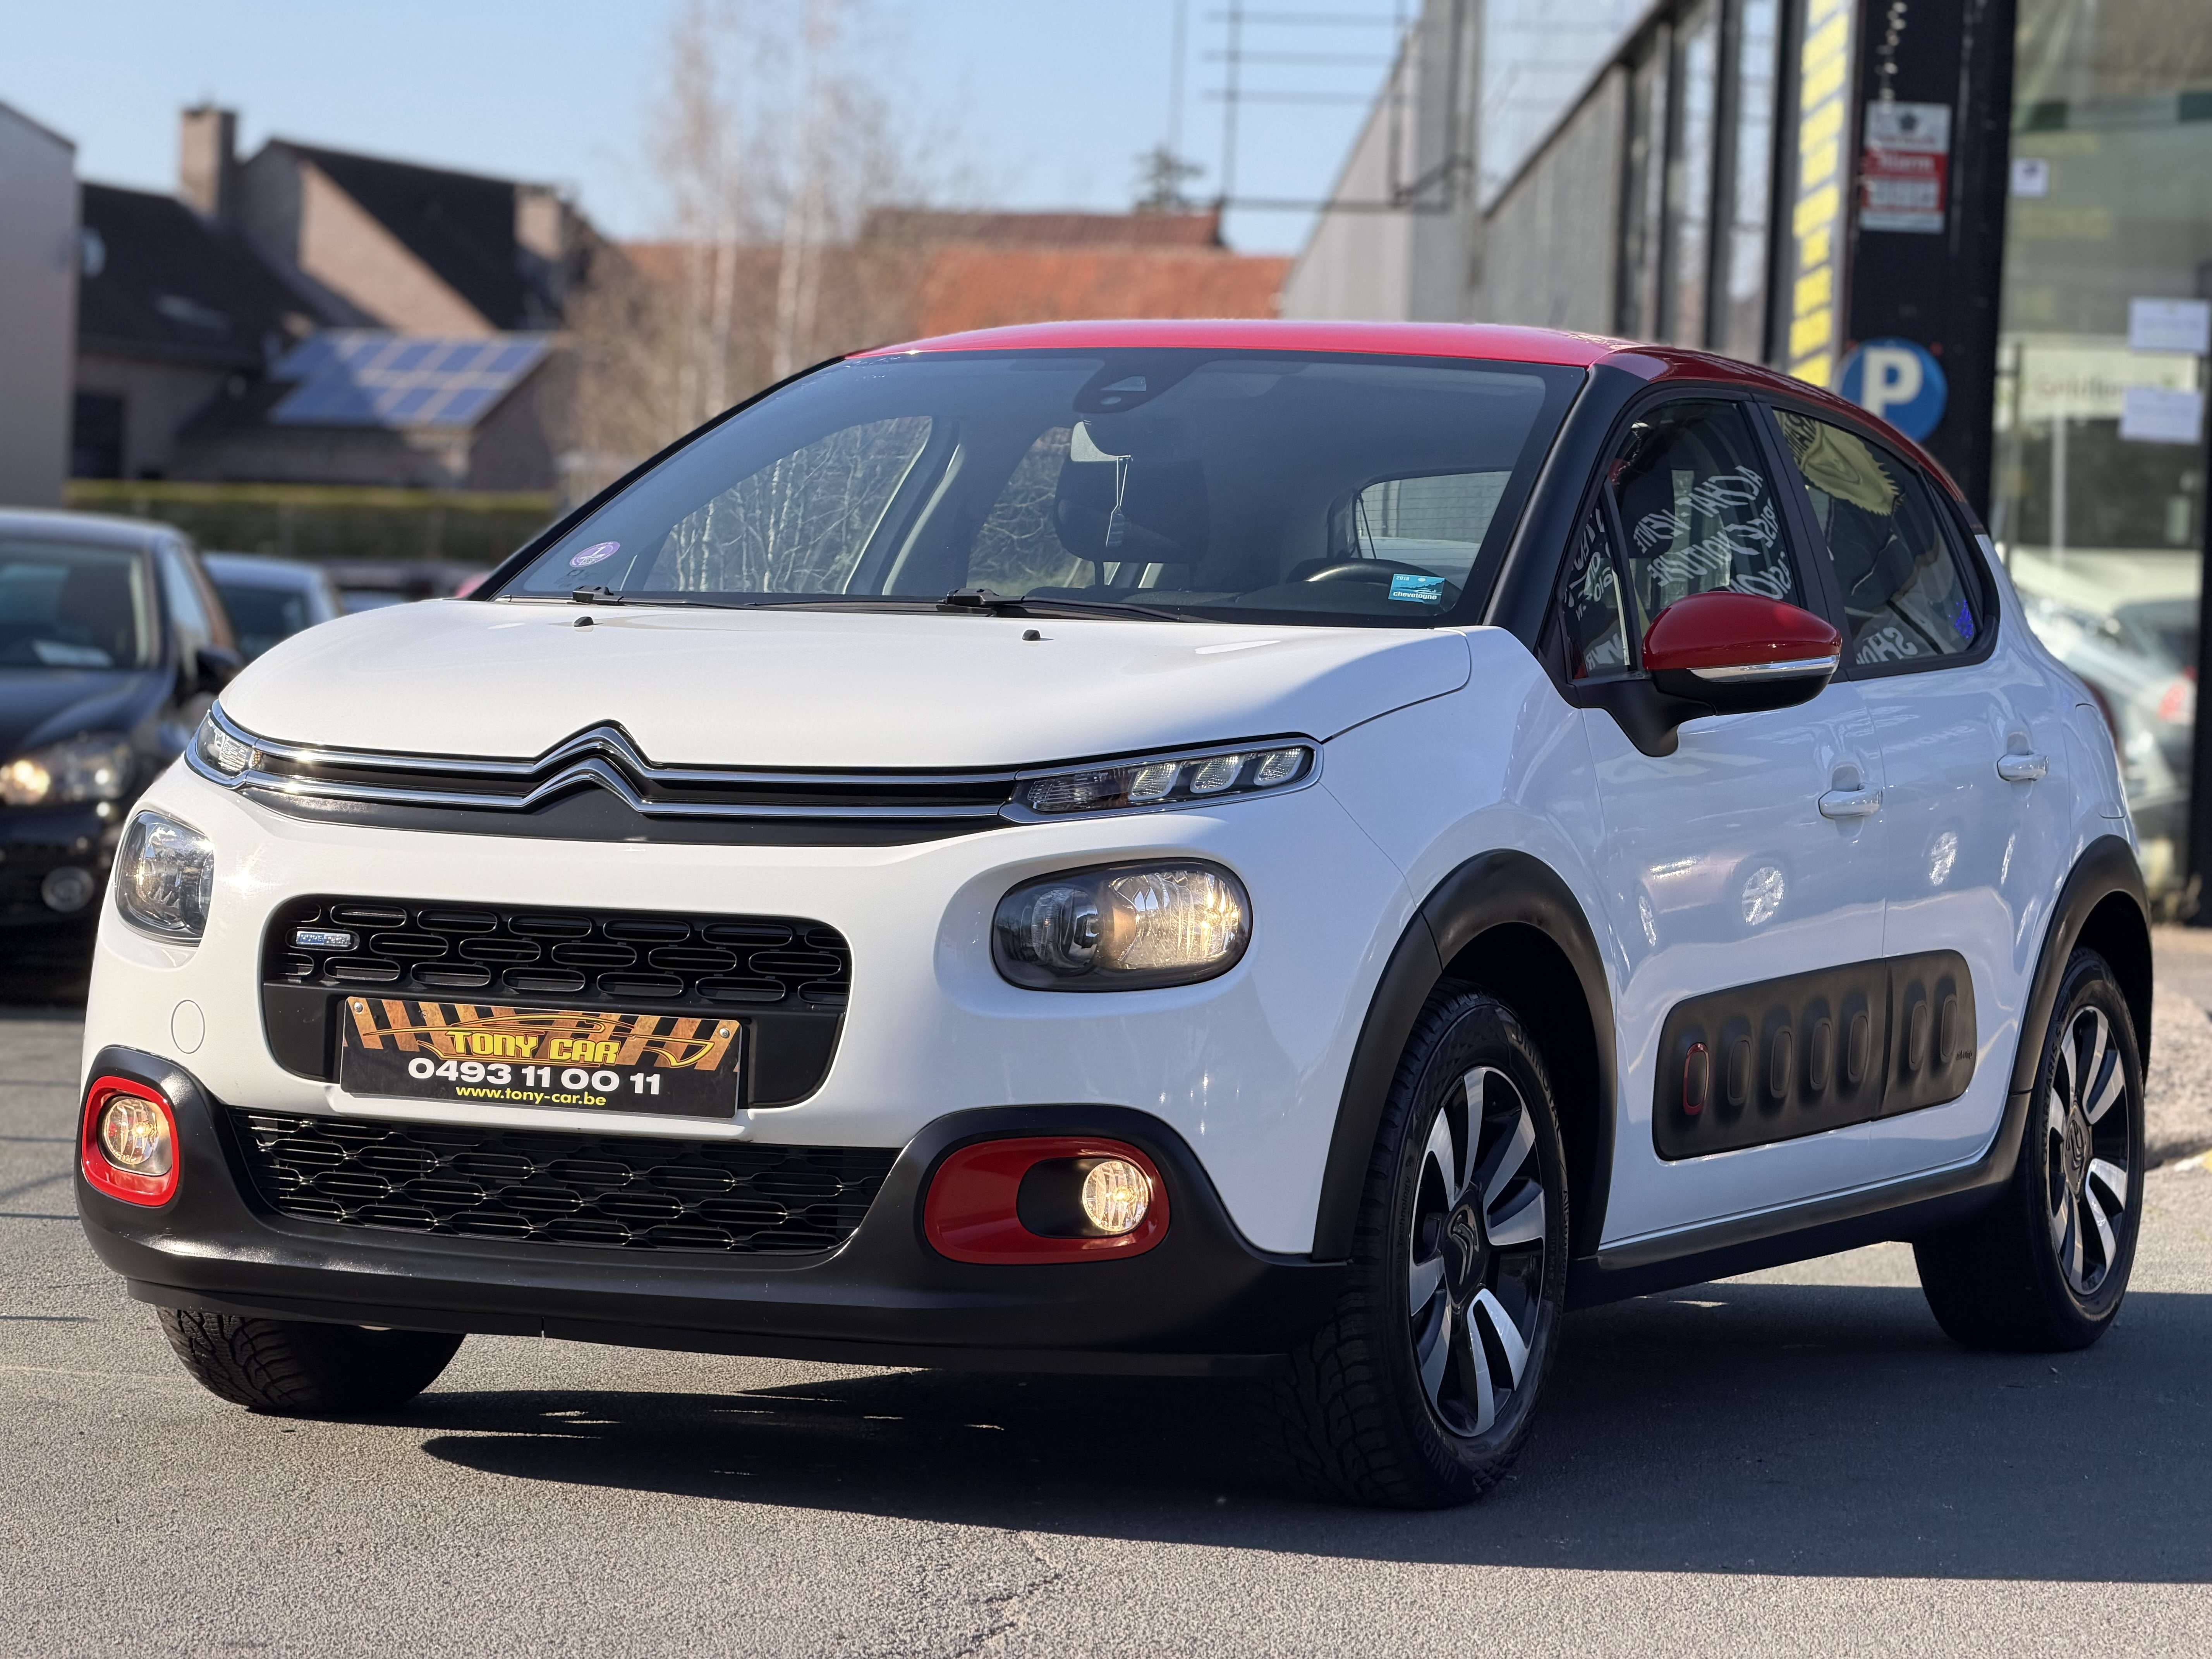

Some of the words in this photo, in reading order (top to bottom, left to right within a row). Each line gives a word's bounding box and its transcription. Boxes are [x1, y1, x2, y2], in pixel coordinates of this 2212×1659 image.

[1862, 347, 1923, 417] P
[1393, 591, 1437, 600] chevetogne
[447, 1030, 537, 1057] TONY
[549, 1038, 621, 1065] CAR
[408, 1058, 512, 1084] 0493
[522, 1067, 551, 1087] 11
[561, 1068, 619, 1091] 00
[630, 1073, 659, 1094] 11
[456, 1086, 606, 1105] www.tony-car.be
